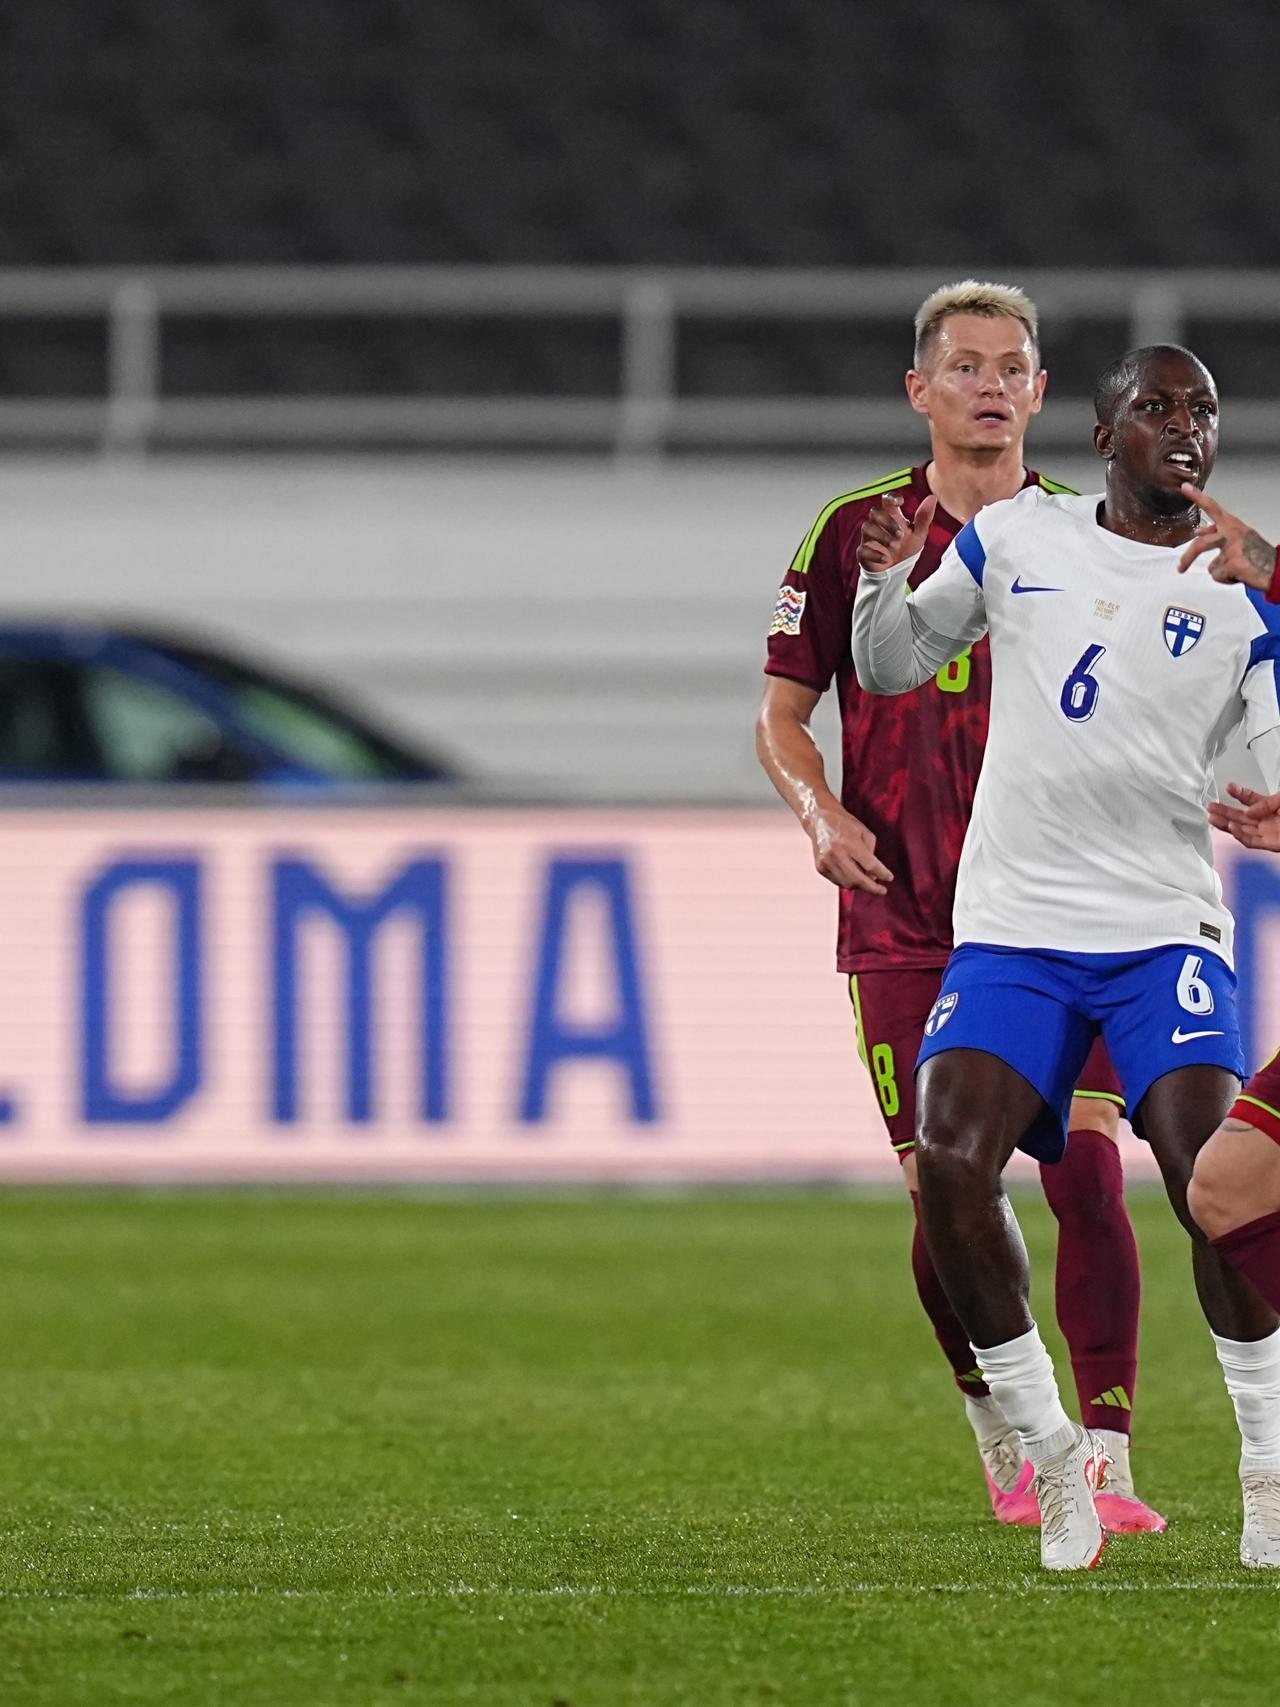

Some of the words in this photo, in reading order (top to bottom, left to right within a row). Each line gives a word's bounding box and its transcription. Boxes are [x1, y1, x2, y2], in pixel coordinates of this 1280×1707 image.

[1060, 643, 1106, 723] 6
[0, 853, 660, 1123] OMA
[1176, 953, 1214, 1016] 6
[872, 1043, 900, 1117] 8
